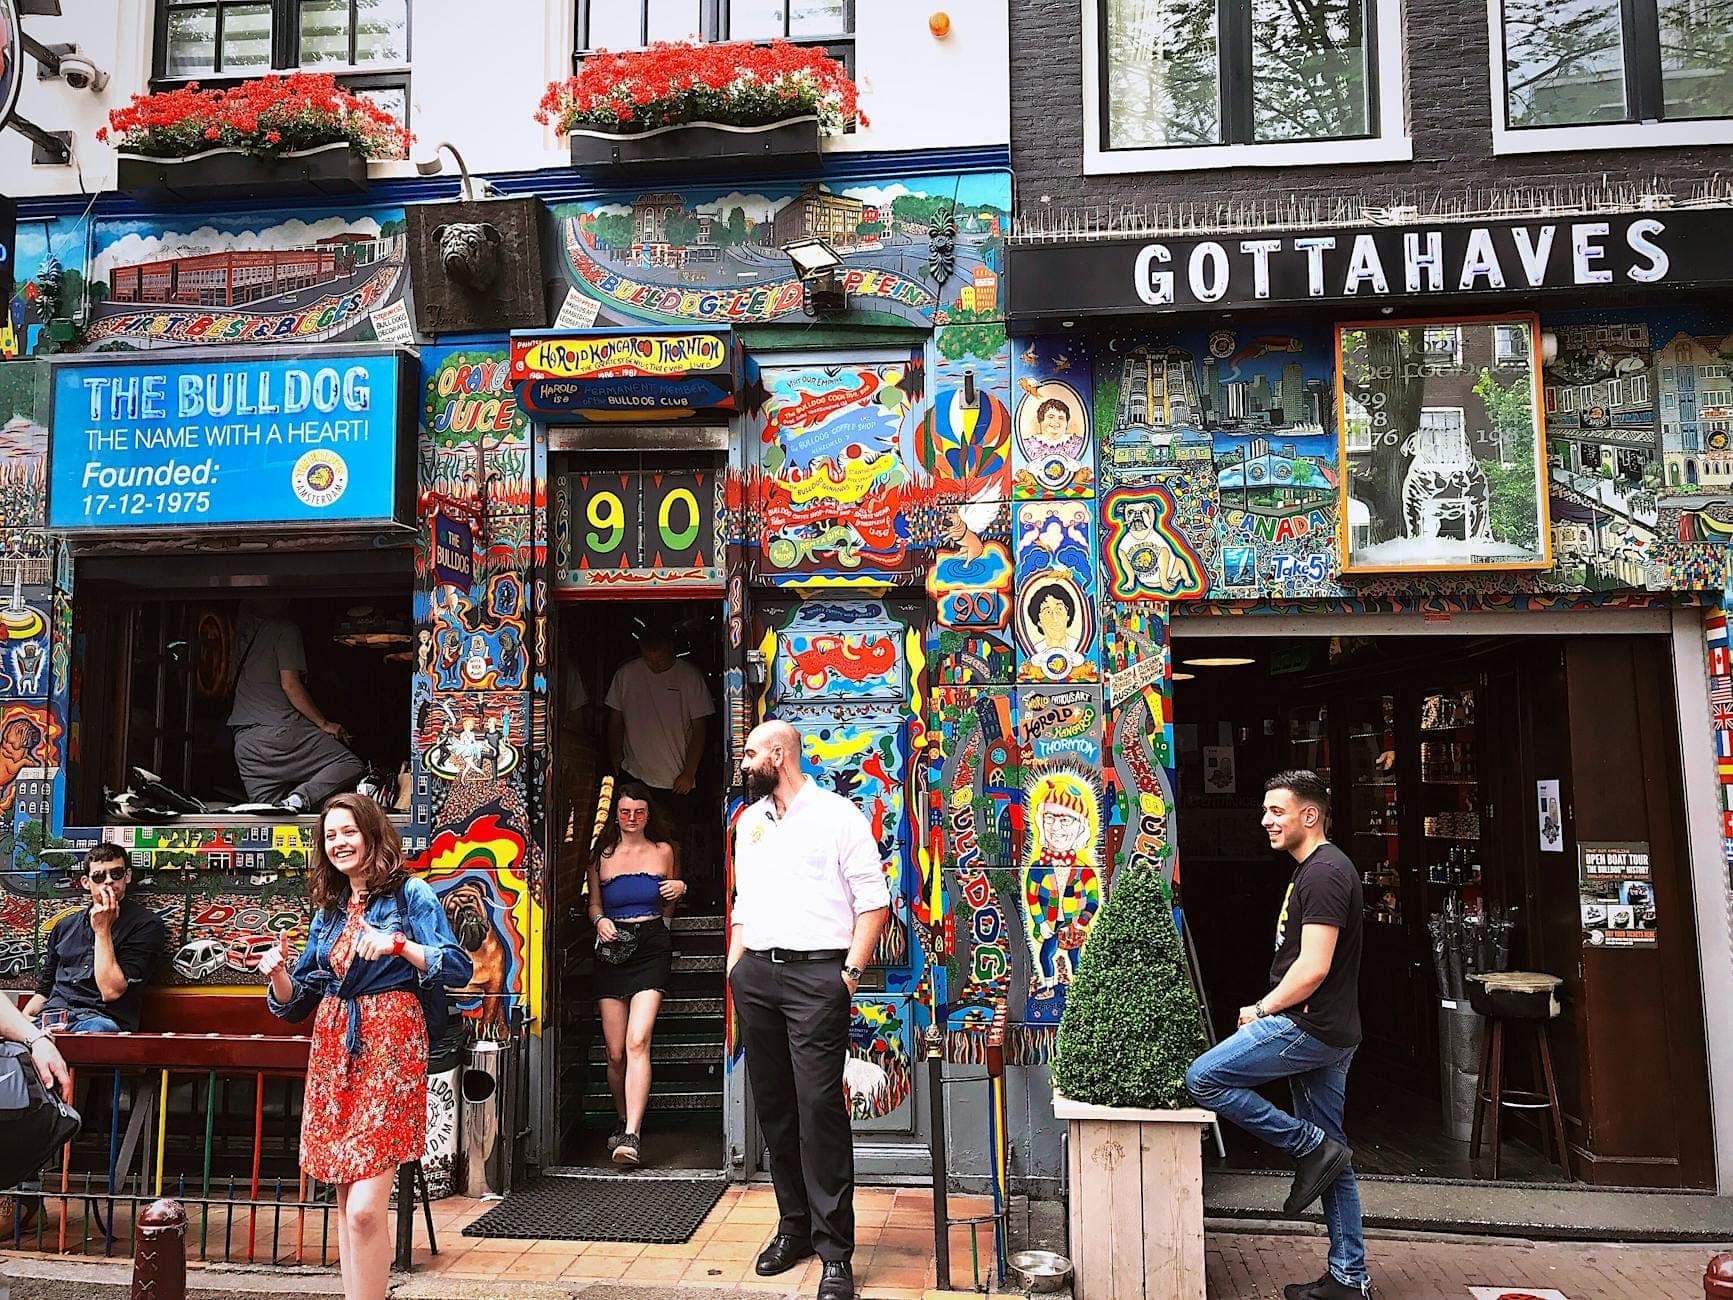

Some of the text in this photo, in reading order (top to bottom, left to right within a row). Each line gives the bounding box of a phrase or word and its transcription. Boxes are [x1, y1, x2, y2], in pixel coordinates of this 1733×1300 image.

[1134, 219, 1670, 305] GOTTAHAVES
[600, 275, 718, 316] BULLDOG
[844, 270, 923, 307] PLEIN
[110, 315, 186, 336] FIRST
[185, 316, 255, 338] BEST
[274, 280, 380, 336] BIGGEST
[540, 342, 589, 373] HAROLD
[82, 366, 371, 421] THE BULLDOG
[540, 383, 579, 400] HAROLD
[584, 382, 656, 396] PERMANENT
[608, 396, 656, 407] BULLDOG
[660, 397, 689, 407] CLUB
[795, 397, 827, 414] BULLDOG
[434, 399, 517, 433] JUICE
[84, 419, 370, 452] THE NAME WITH A HEART!
[798, 432, 831, 450] BULLDOG
[81, 458, 221, 489] Founded:
[82, 491, 211, 516] 17-12-1975
[295, 484, 344, 506] AMSTERDAM
[447, 529, 461, 549] THE
[1226, 509, 1326, 545] CANADA
[436, 546, 471, 575] BULLDOG
[953, 591, 995, 622] 90
[1025, 695, 1050, 710] WORLD
[1585, 853, 1649, 866] OPEN BOAT TOUR
[1586, 865, 1598, 874] THE
[1626, 865, 1649, 875] HISTORY
[951, 786, 1007, 983] BULLDOG
